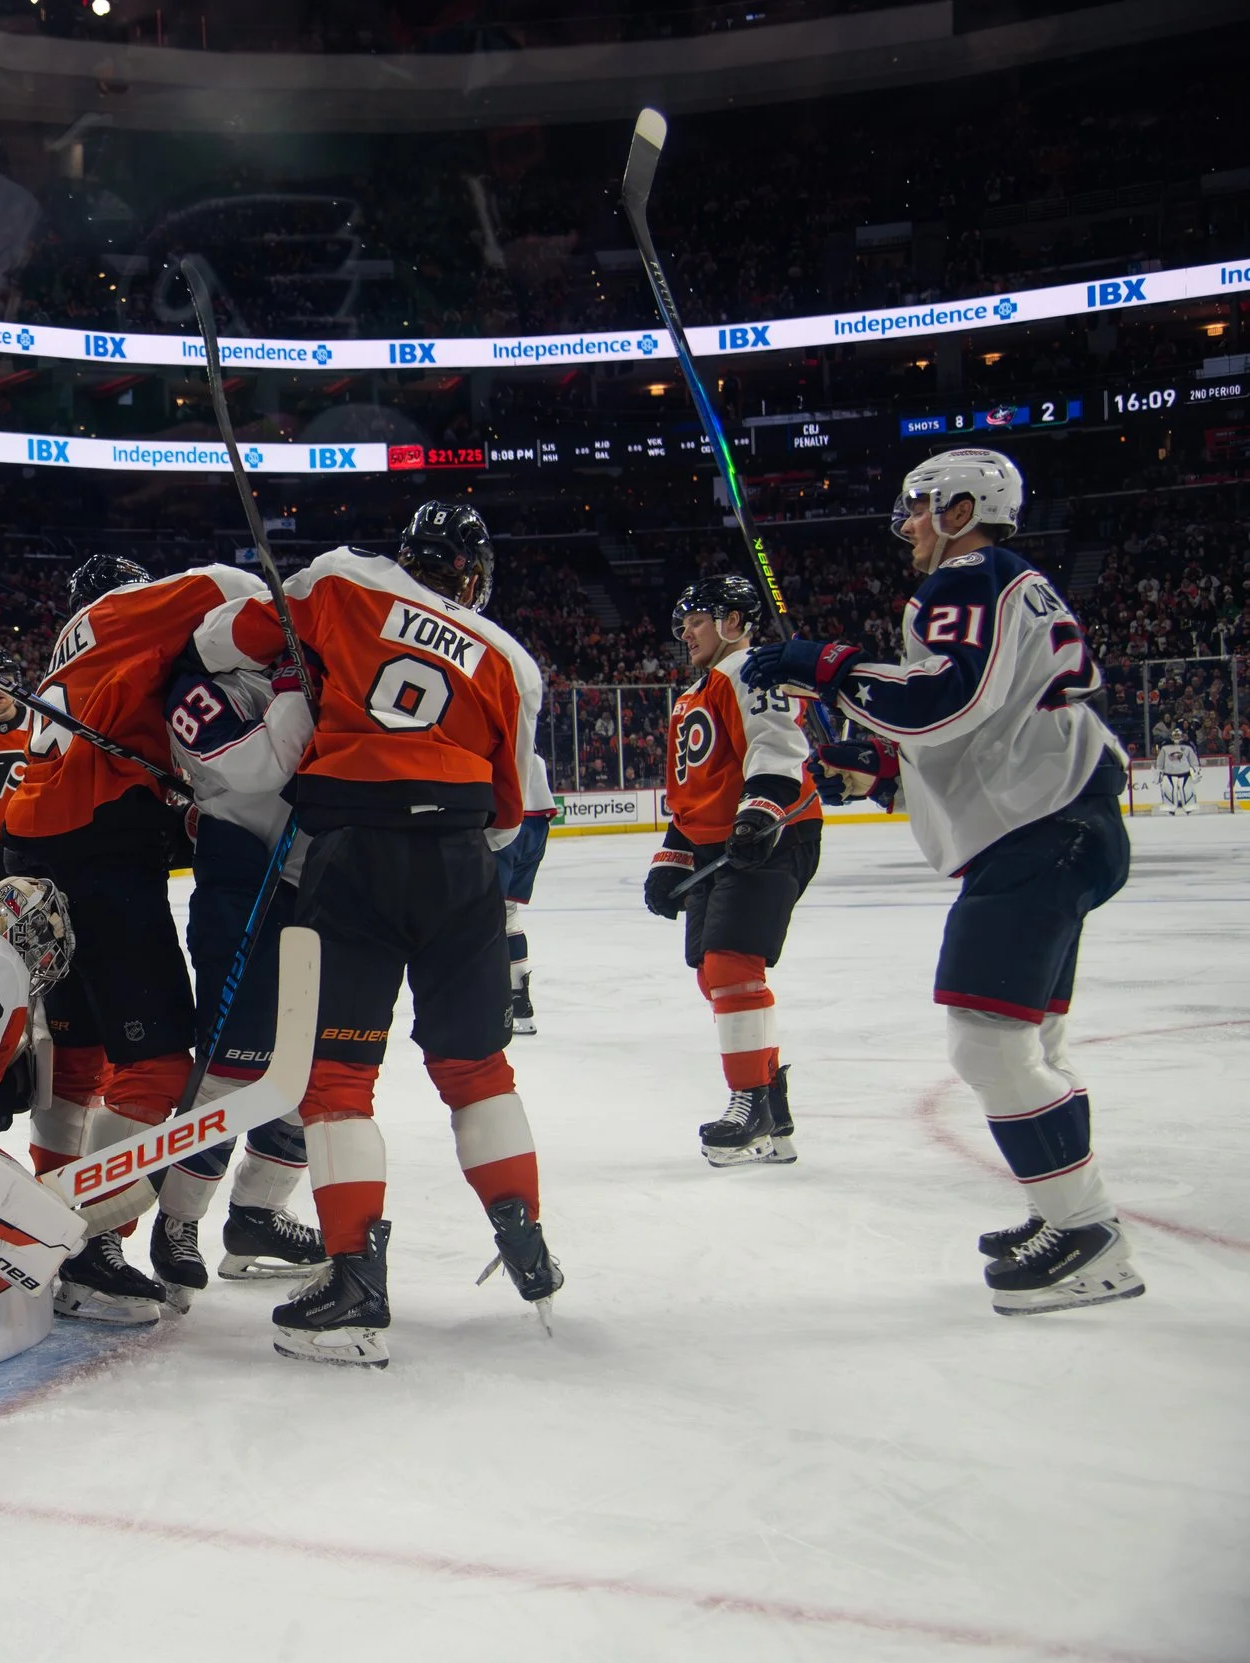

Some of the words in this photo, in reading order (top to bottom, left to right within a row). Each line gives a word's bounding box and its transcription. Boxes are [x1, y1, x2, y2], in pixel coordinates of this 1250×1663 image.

[1087, 278, 1147, 308] IBX
[834, 304, 987, 335] Independence
[84, 334, 126, 359] IBX
[719, 325, 771, 350] IBX
[183, 341, 307, 361] Indpendence
[389, 343, 436, 364] IBX
[493, 338, 631, 361] Independence
[1114, 389, 1176, 413] 16:09
[1190, 390, 1206, 400] 2ND
[1209, 385, 1240, 398] PERIOD
[1042, 402, 1054, 421] 2
[803, 424, 819, 436] CBJ
[908, 421, 940, 432] SHOTS
[955, 415, 963, 429] 8
[28, 439, 69, 462] IBX
[794, 435, 829, 448] PENALTY
[113, 446, 231, 467] Independenc
[309, 448, 356, 468] IBX
[391, 451, 420, 464] 50/50
[428, 449, 483, 464] $21,725
[491, 450, 515, 461] 8:08
[517, 449, 533, 460] PM
[433, 511, 446, 525] 8
[757, 551, 787, 614] BAUER
[926, 604, 986, 648] 21
[399, 609, 474, 669] YORK
[170, 683, 224, 746] 83
[556, 799, 635, 818] enterprise
[73, 1109, 228, 1197] BAUER
[1048, 1249, 1082, 1274] BAUER
[305, 1300, 336, 1317] BAUER
